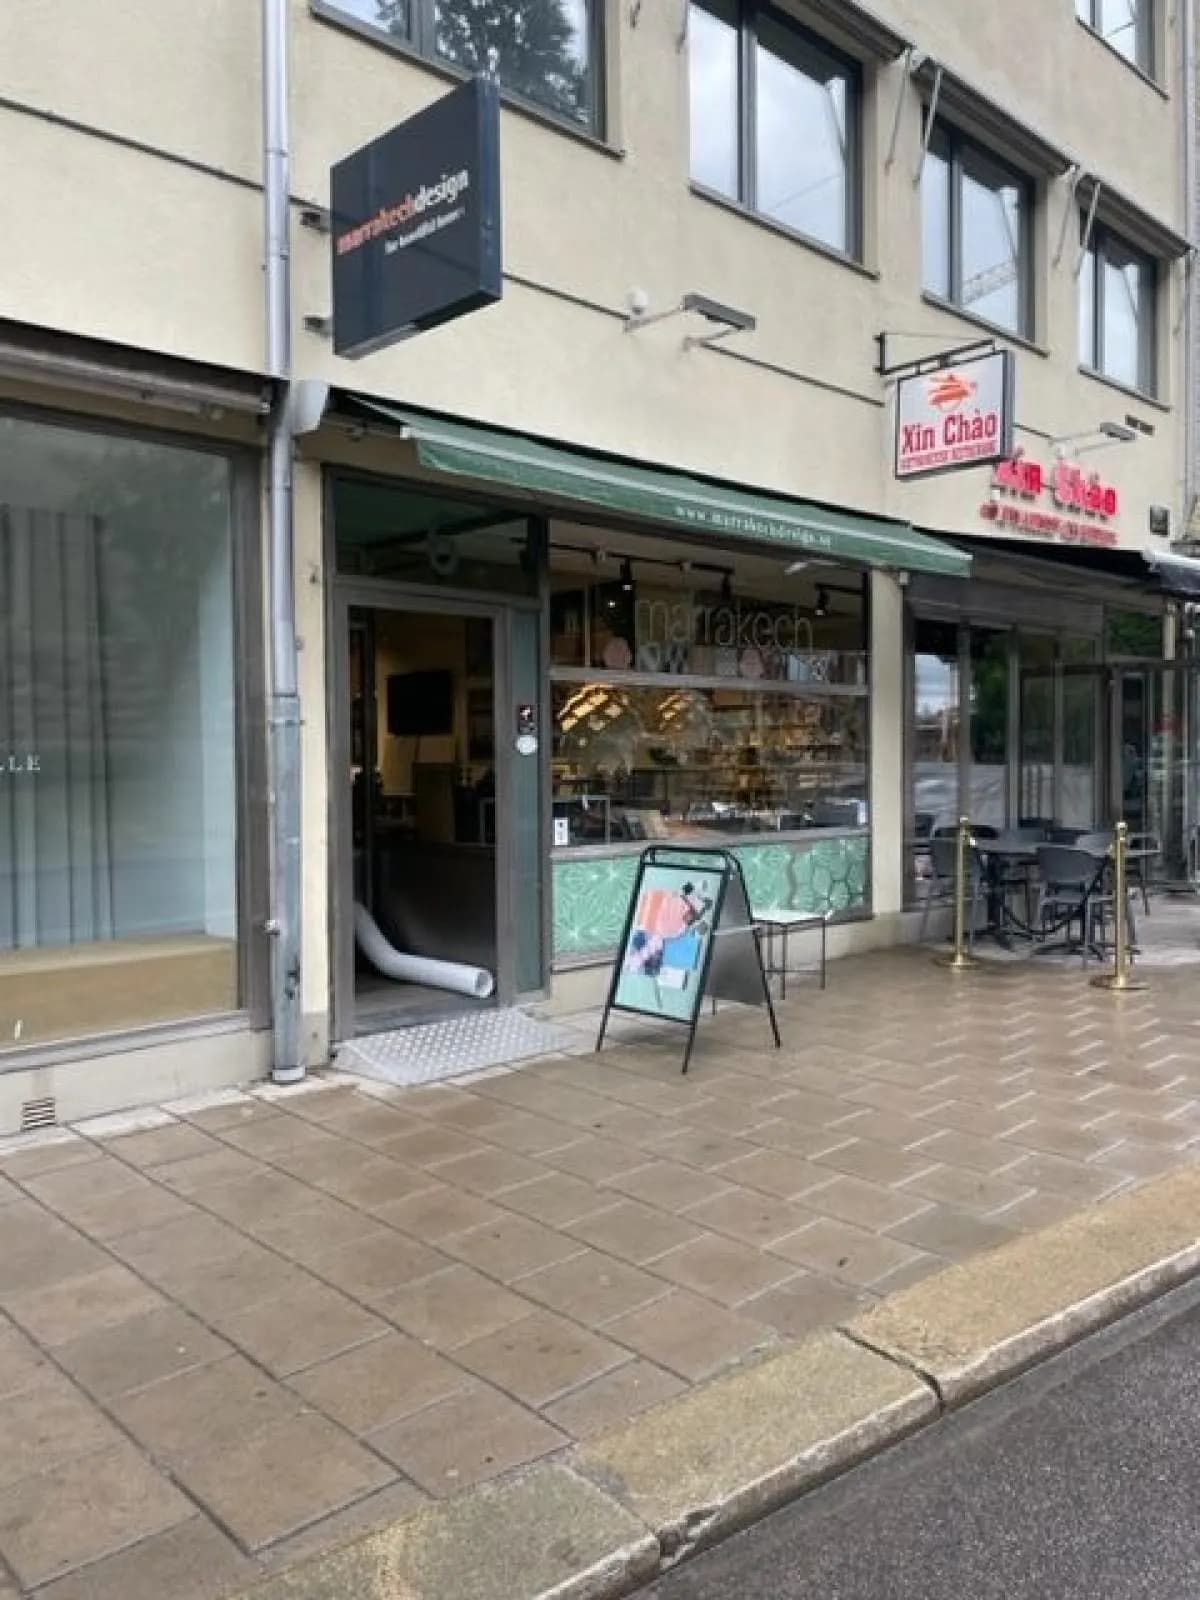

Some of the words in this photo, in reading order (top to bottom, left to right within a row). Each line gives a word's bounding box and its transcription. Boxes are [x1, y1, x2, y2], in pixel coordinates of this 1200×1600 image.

[902, 424, 936, 455] Xin
[943, 408, 998, 446] Chào
[635, 599, 815, 656] marrakech
